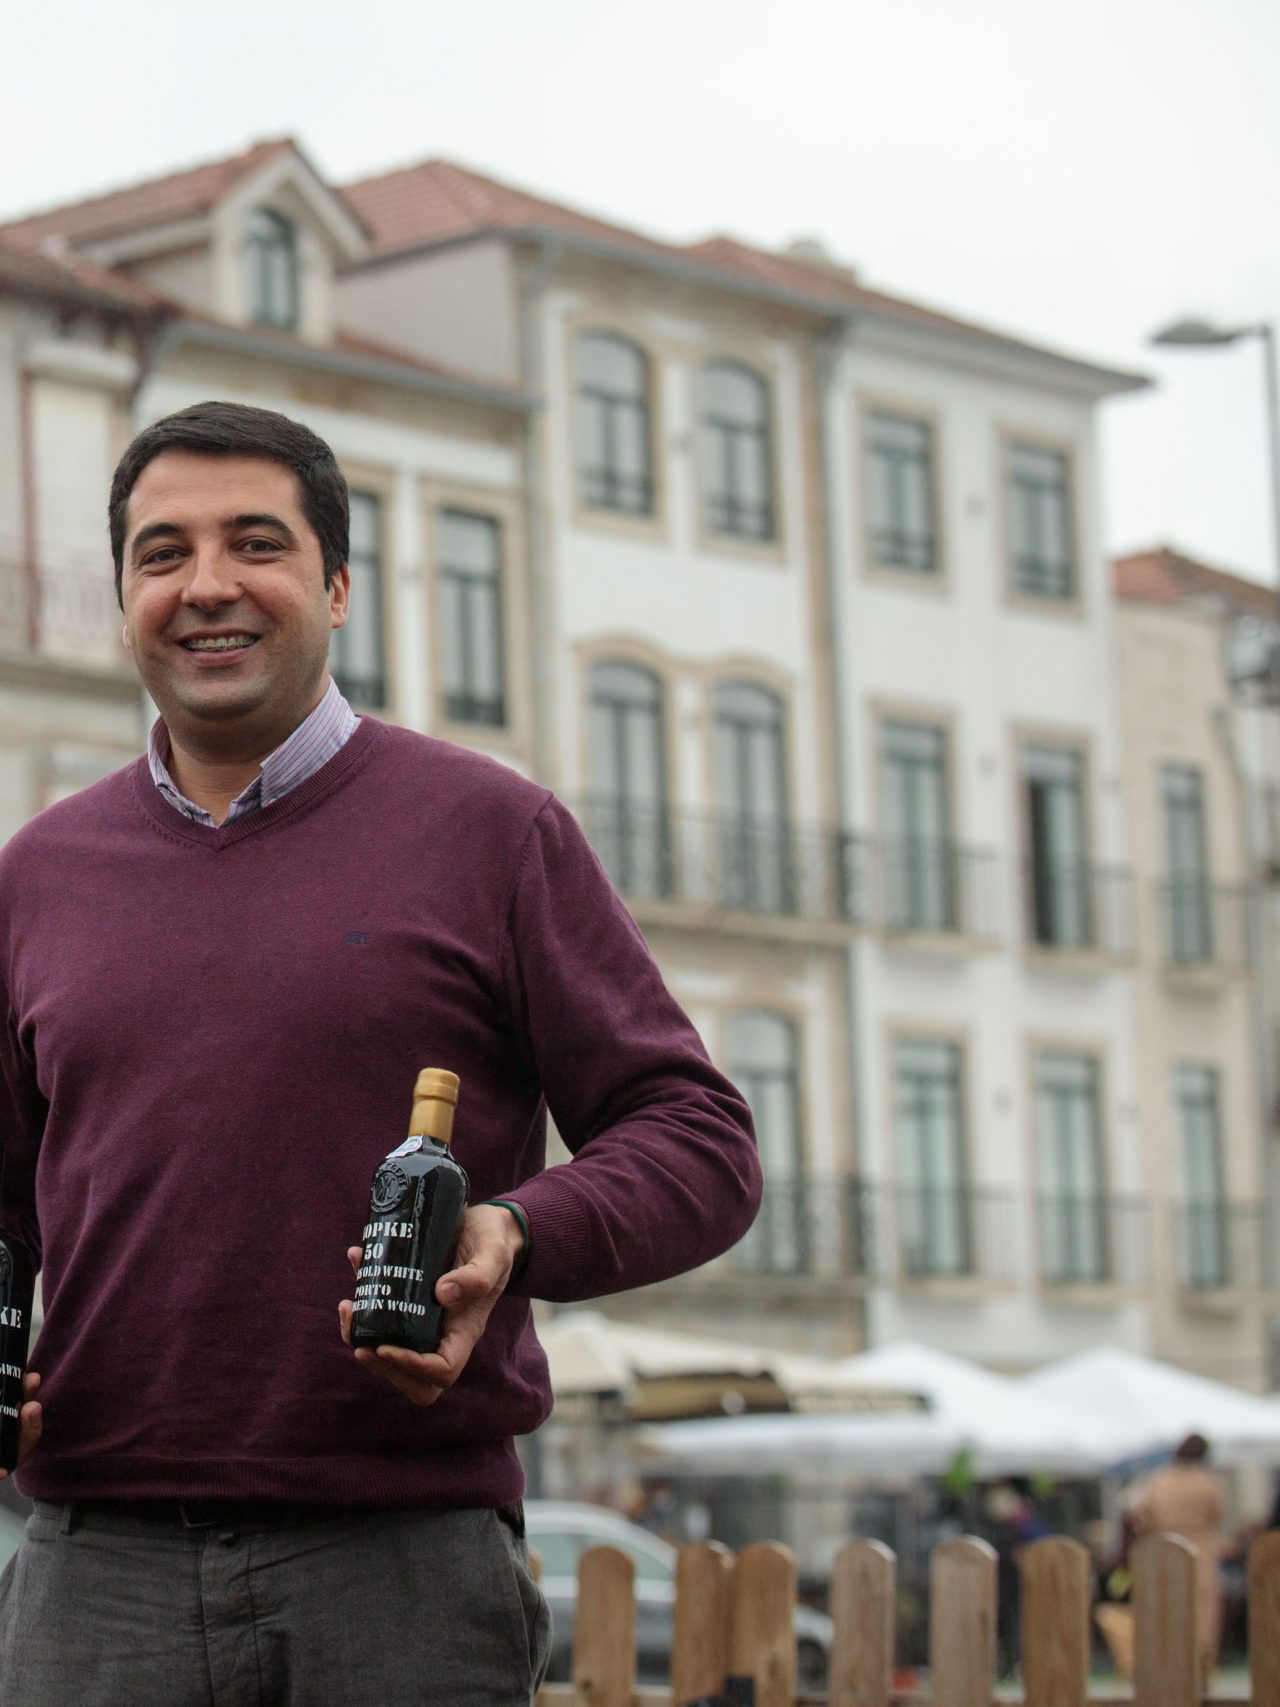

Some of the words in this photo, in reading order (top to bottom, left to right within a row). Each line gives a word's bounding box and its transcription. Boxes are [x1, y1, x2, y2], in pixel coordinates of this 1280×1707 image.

[364, 1243, 384, 1260] 50
[363, 1265, 381, 1278] OLD
[383, 1265, 424, 1282] WHITE
[354, 1284, 392, 1299] PORTO
[371, 1298, 384, 1310] IN
[387, 1299, 426, 1316] WOOD
